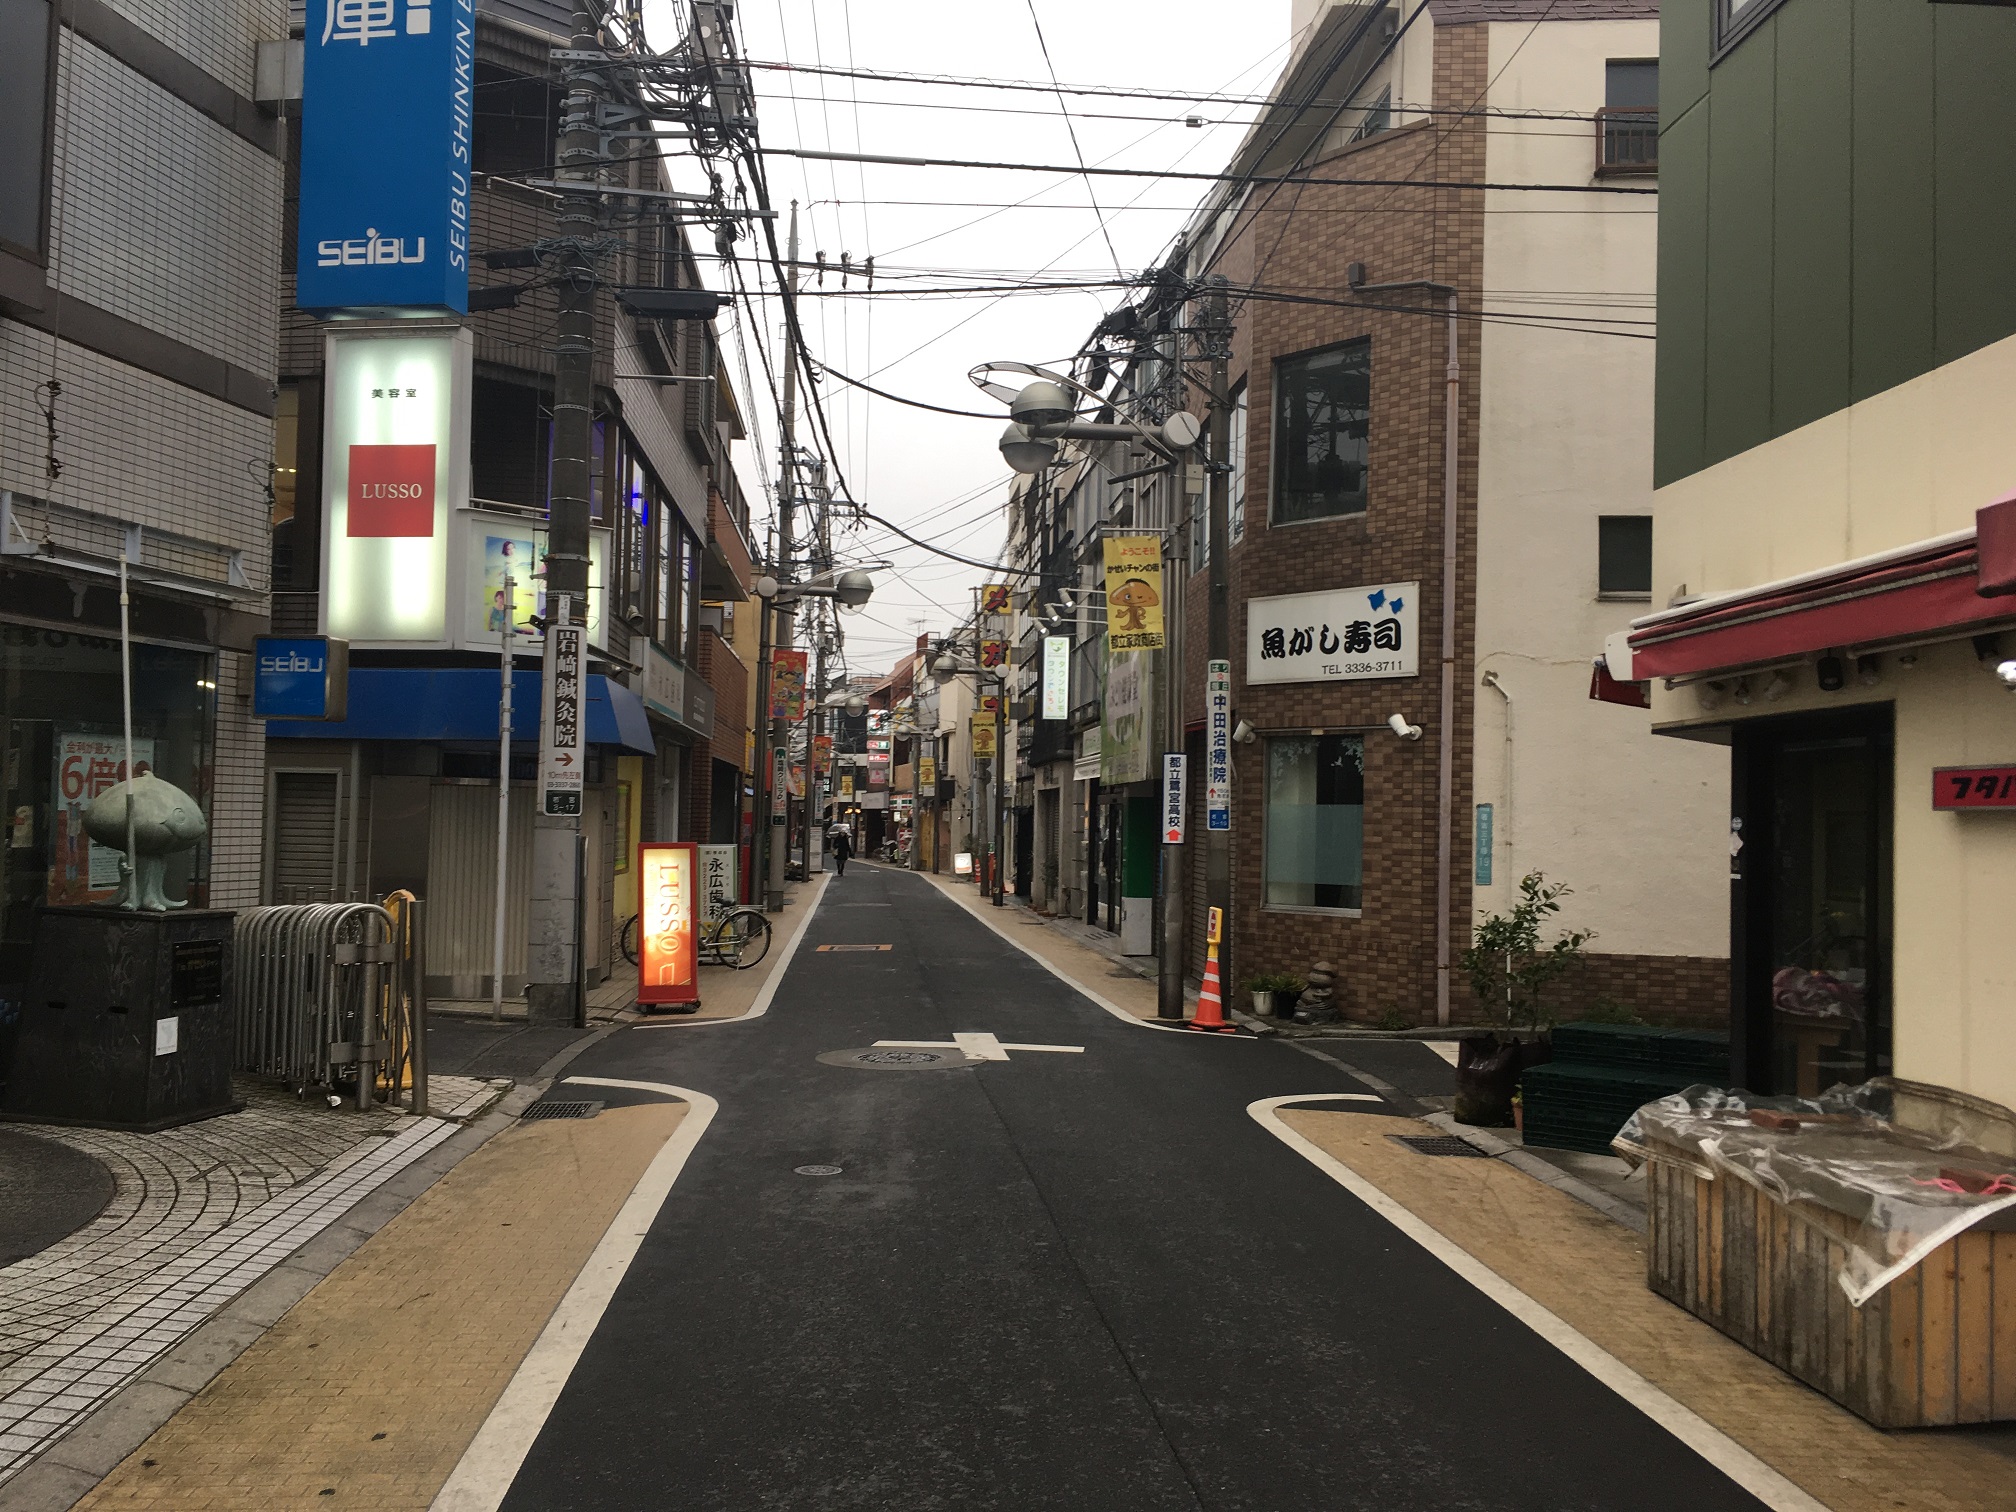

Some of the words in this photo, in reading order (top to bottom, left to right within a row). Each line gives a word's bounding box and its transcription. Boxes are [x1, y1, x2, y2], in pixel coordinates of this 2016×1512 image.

[452, 18, 472, 165] SHINKIN
[450, 171, 467, 272] SEIBU
[317, 227, 426, 267] SEIBU
[371, 388, 417, 399] 美容室
[361, 483, 423, 499] LUSSO
[1261, 617, 1402, 660] 魚がし寿司
[260, 651, 324, 673] SEIBU
[1322, 665, 1342, 675] TEL
[1345, 660, 1403, 674] 3336-3711
[1213, 694, 1227, 784] 中田治療院
[660, 863, 680, 954] LUSSO
